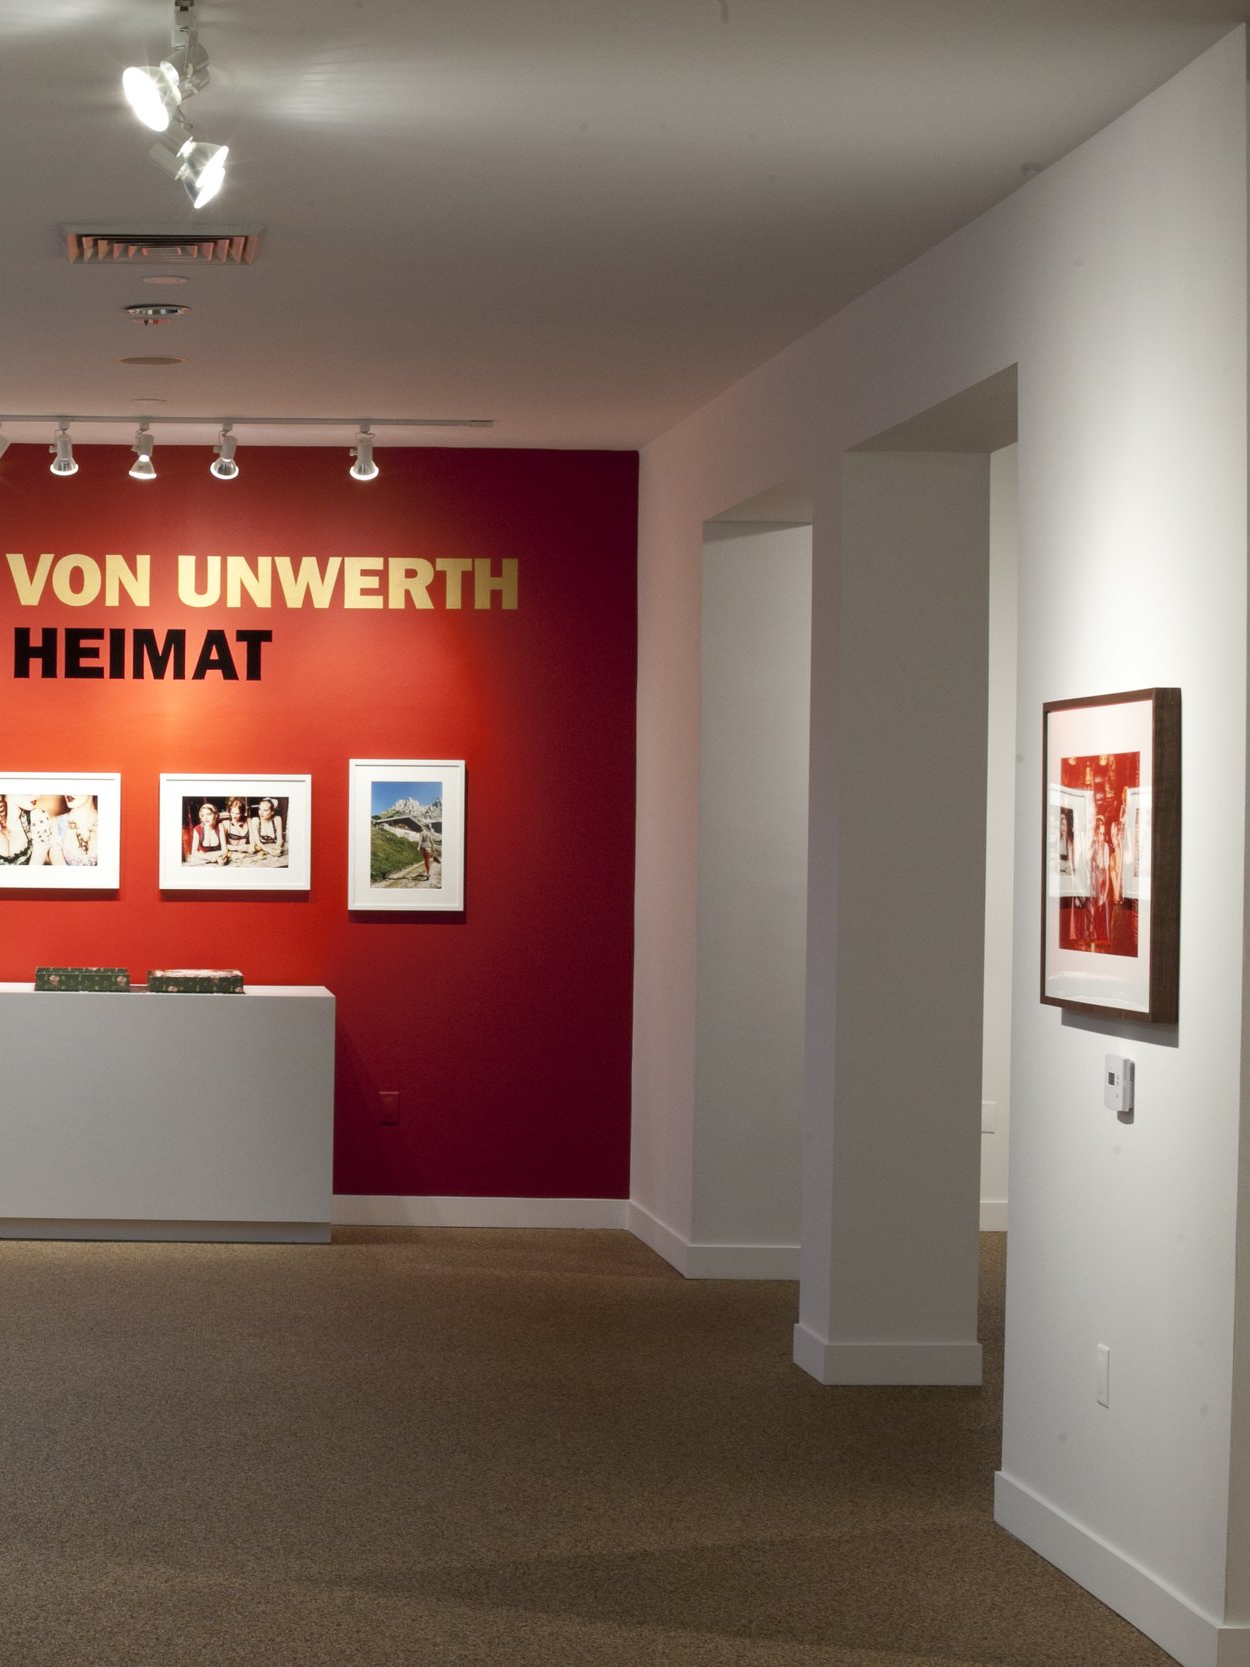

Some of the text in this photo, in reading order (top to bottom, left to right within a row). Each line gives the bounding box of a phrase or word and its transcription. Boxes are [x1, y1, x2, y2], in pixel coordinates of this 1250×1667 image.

[5, 553, 151, 608] VON
[176, 555, 519, 610] UNWERTH
[13, 626, 273, 681] HEIMAT
